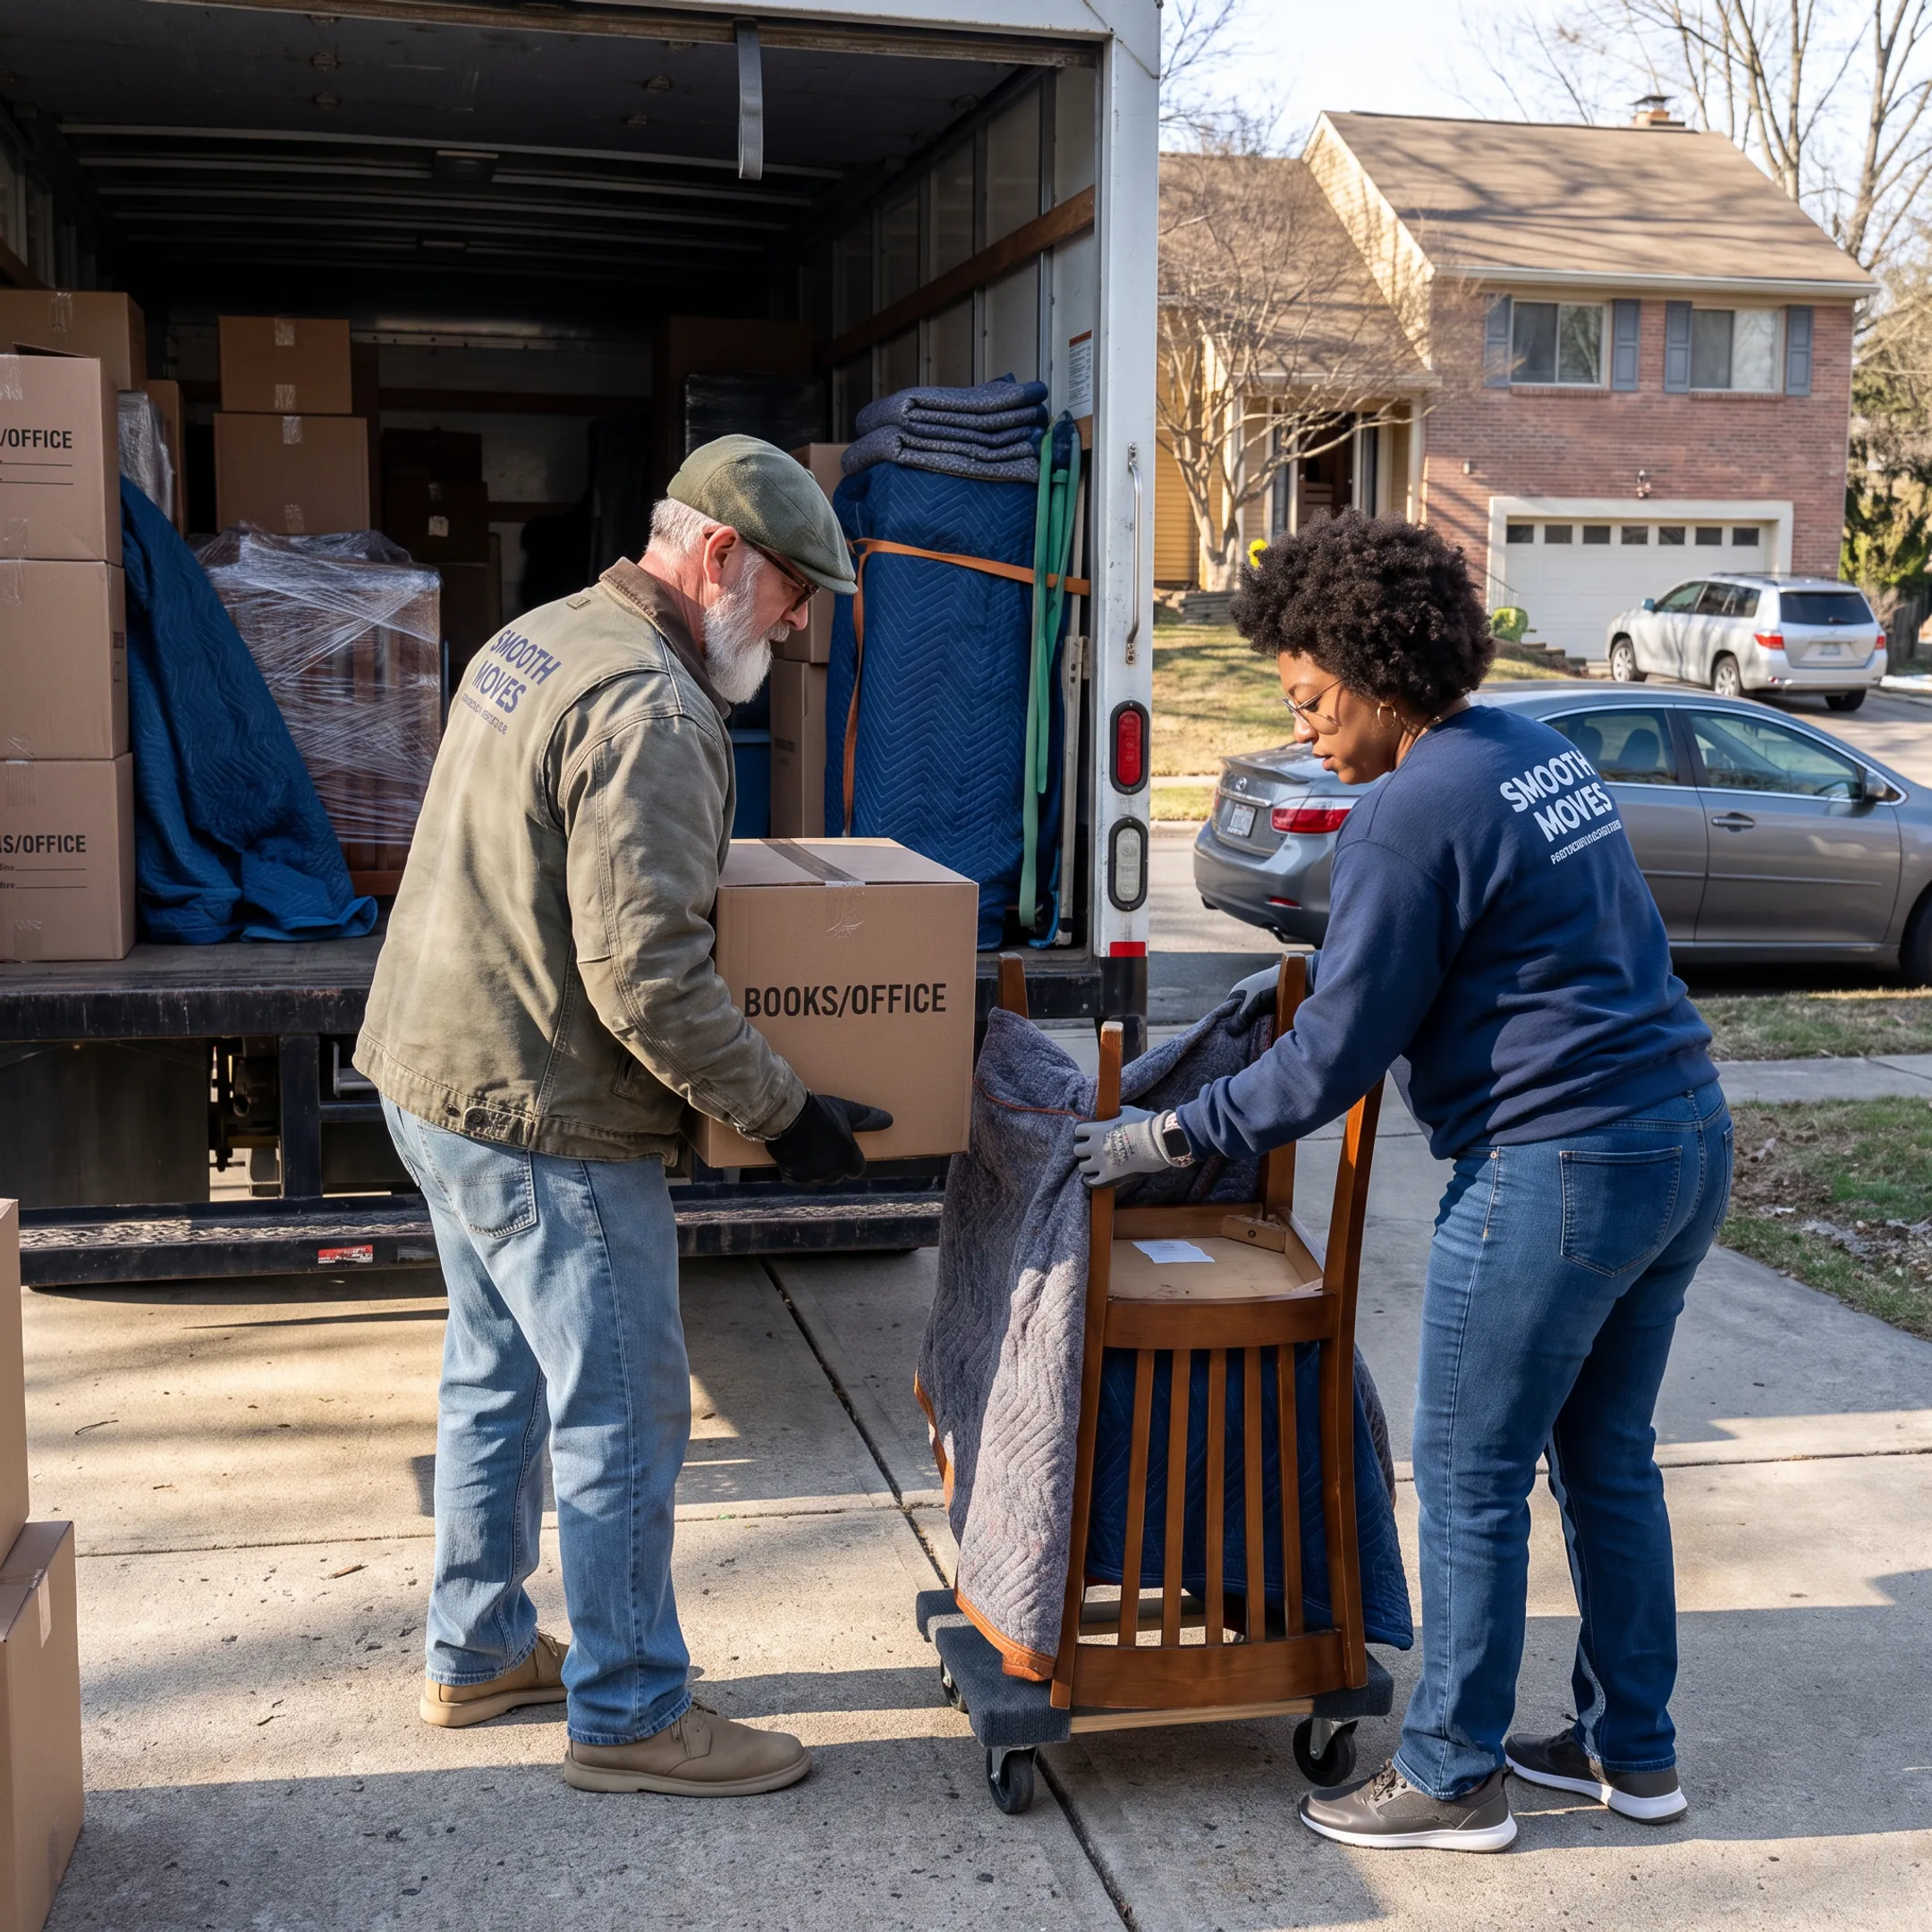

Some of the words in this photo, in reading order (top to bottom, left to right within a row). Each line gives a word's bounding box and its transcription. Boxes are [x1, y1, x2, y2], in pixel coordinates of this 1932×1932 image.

[490, 629, 562, 685] SMOOTH
[471, 660, 527, 714] MOVES
[1500, 750, 1596, 813] SMOOTH
[1533, 782, 1613, 843] MOVES
[0, 835, 87, 854] S/OFFICE
[744, 983, 946, 1018] BOOKS/OFFICE
